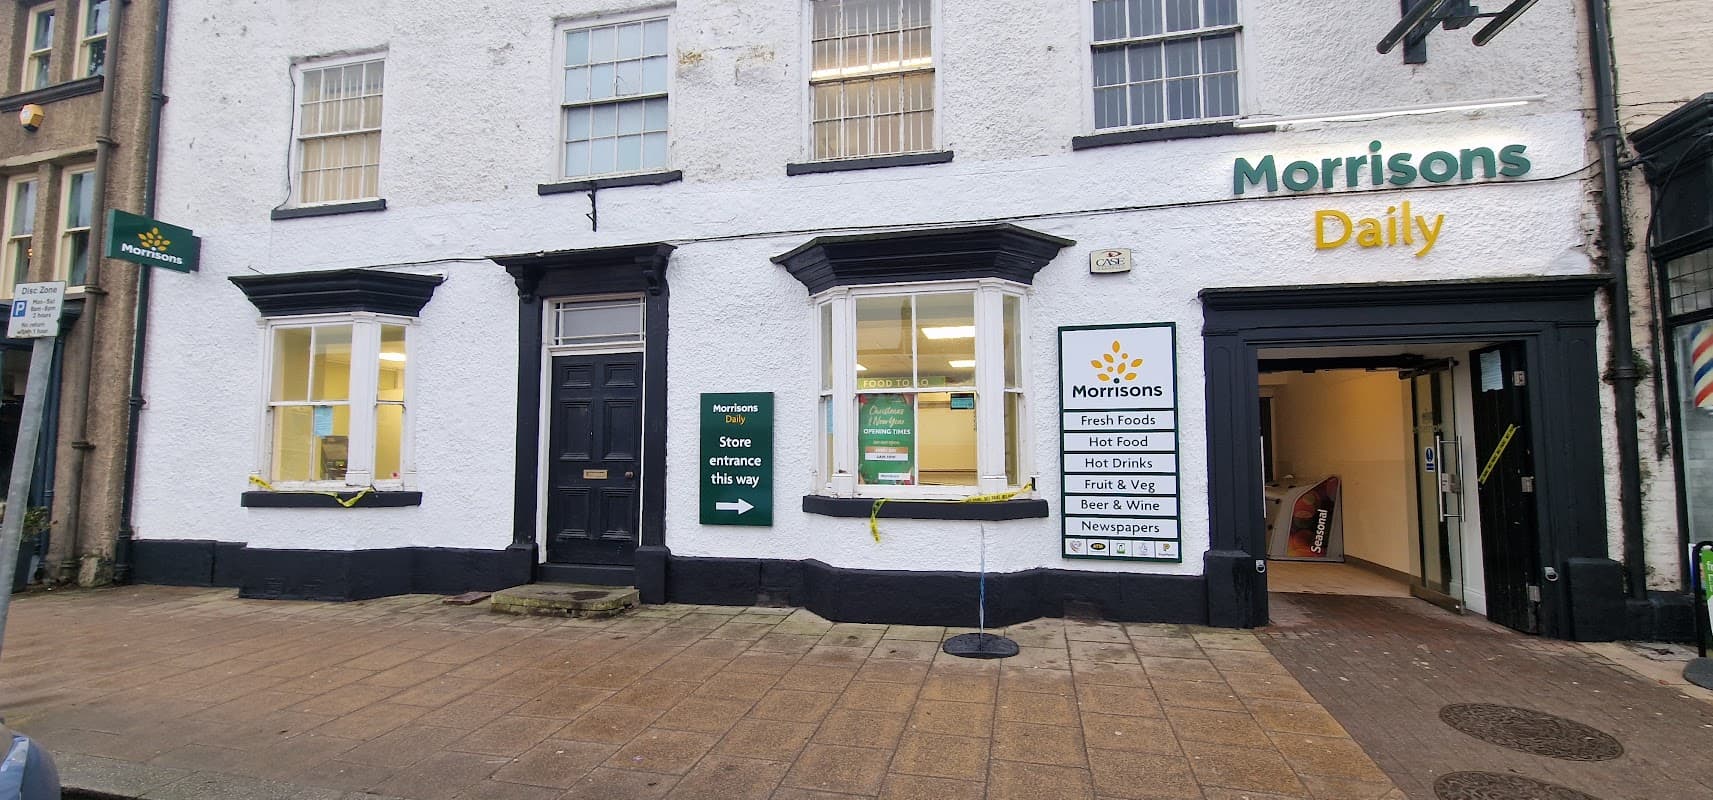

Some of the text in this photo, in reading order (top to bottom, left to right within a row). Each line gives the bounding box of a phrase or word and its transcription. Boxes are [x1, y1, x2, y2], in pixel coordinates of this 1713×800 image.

[1233, 139, 1532, 195] Morrisons
[1314, 201, 1445, 257] Daily
[121, 242, 183, 265] Morrisons
[1095, 258, 1126, 267] CASE
[21, 286, 58, 295] Disc Zone
[15, 302, 26, 317] P
[863, 379, 893, 388] FOOD
[896, 379, 910, 387] TO
[1072, 378, 1164, 398] Morrisons
[712, 403, 759, 413] Morrisons
[725, 414, 746, 425] Daily
[1081, 414, 1156, 427] Fresh Foods
[719, 436, 752, 448] Store
[1089, 436, 1149, 447] Hot Food
[709, 456, 762, 467] entrance
[1085, 458, 1153, 469] Hot Drinks
[710, 472, 760, 488] this way
[1084, 479, 1156, 493] Fruit & Veg
[1081, 500, 1160, 511] Beer & Wine
[1081, 520, 1160, 535] Newspapers
[1310, 508, 1329, 553] Seasonal
